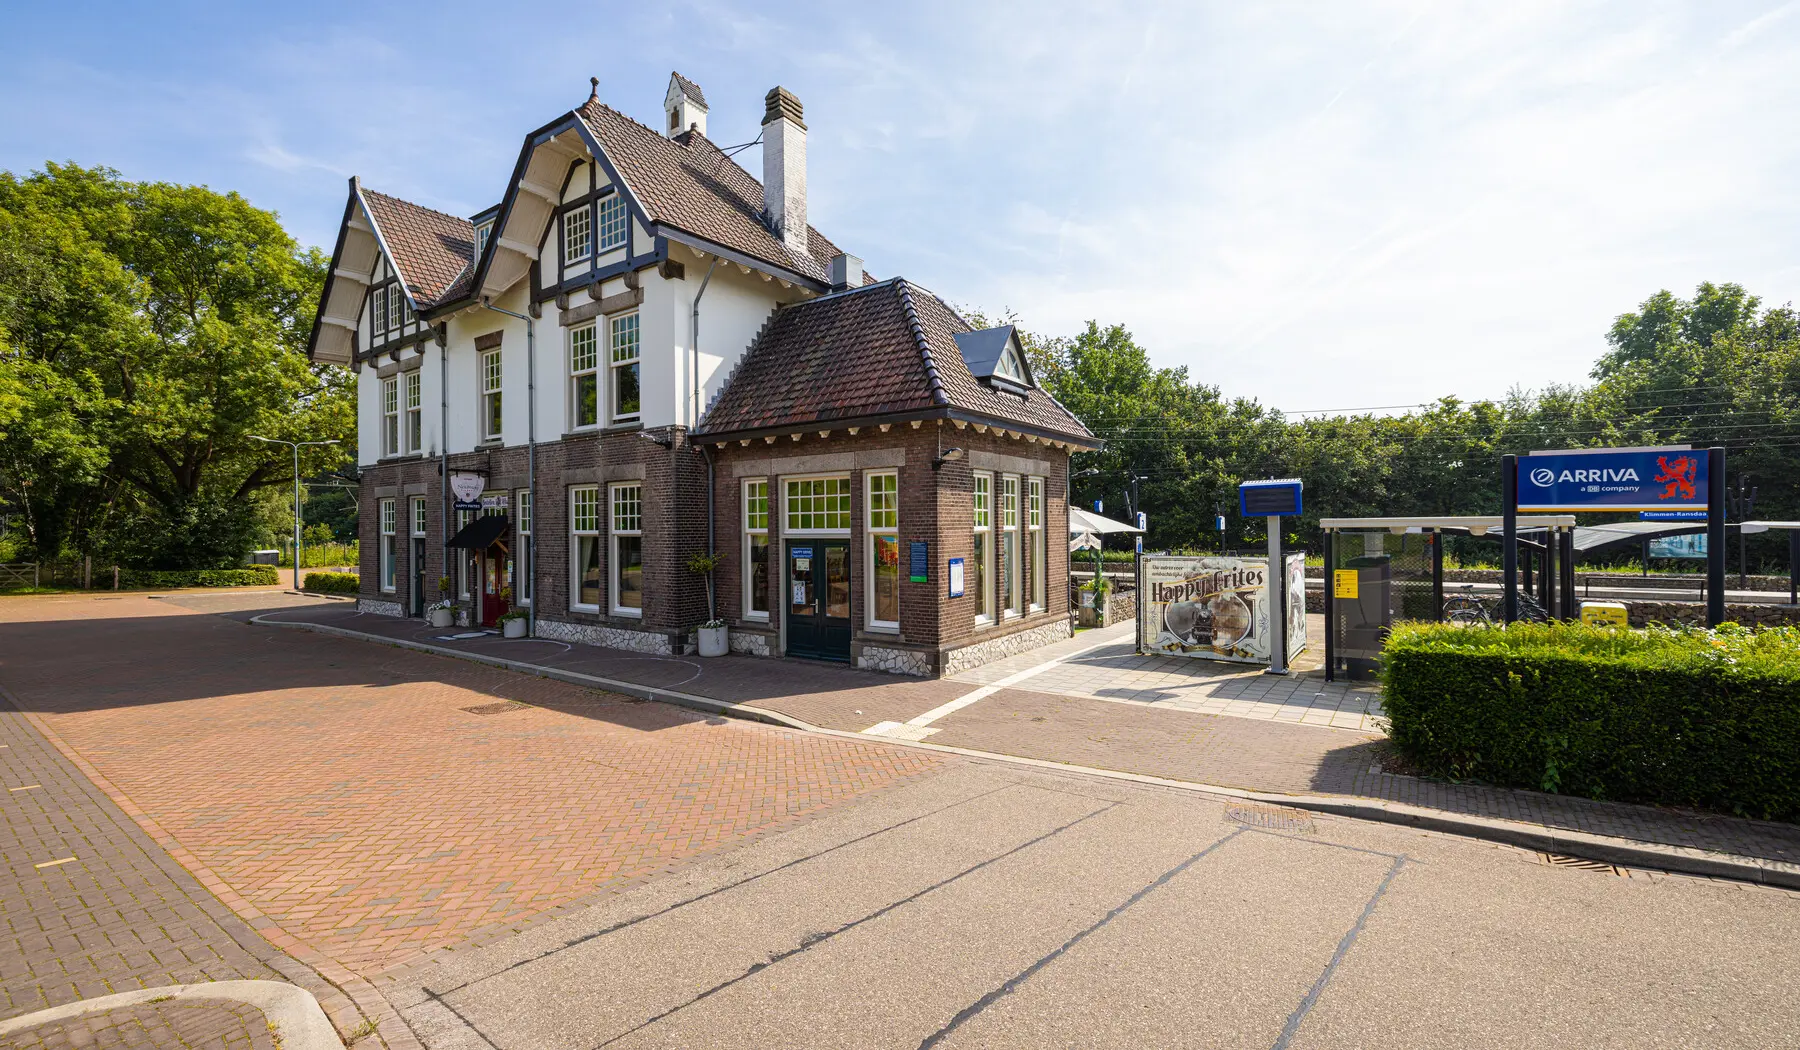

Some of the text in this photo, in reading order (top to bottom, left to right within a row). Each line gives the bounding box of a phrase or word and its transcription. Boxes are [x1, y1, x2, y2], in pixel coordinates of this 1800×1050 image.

[1558, 469, 1640, 482] ARRIVA
[1141, 520, 1145, 529] 2
[1152, 579, 1206, 603] Happy
